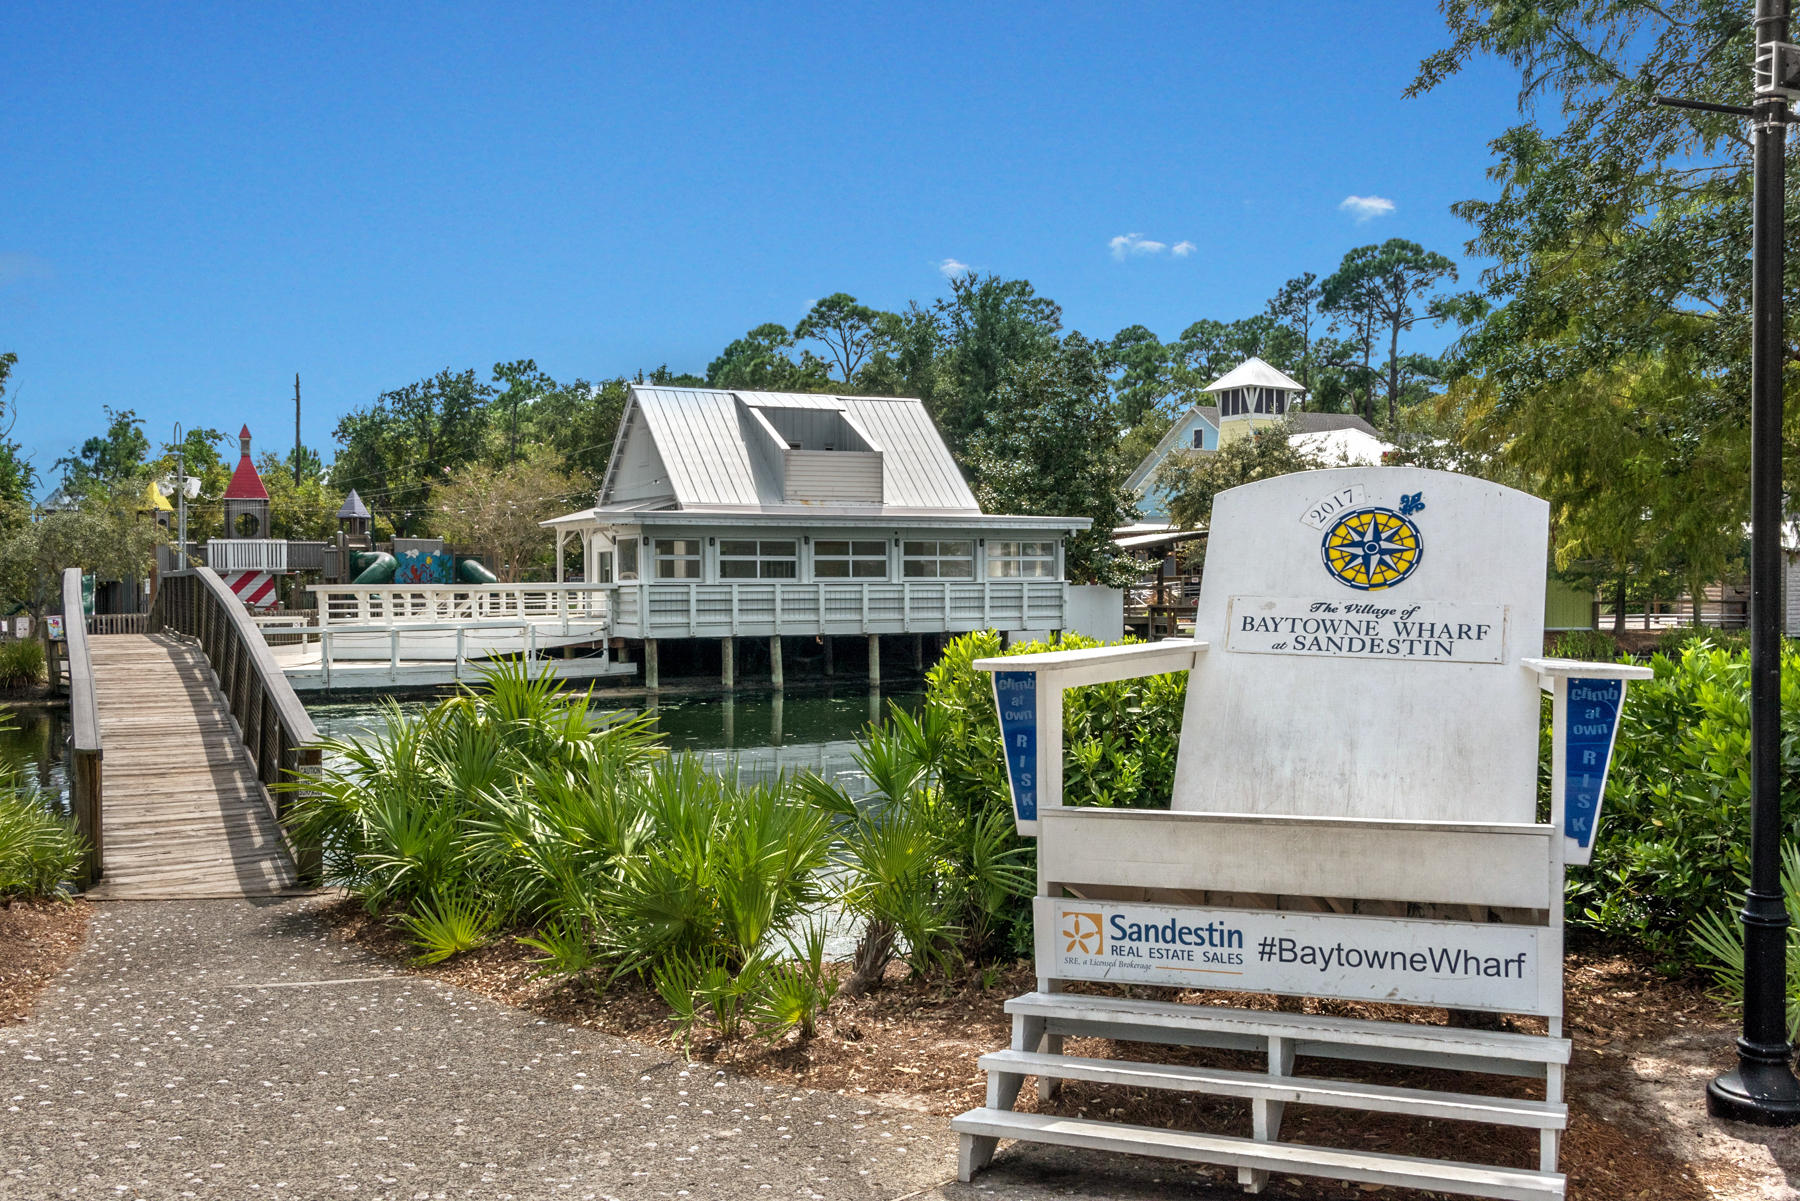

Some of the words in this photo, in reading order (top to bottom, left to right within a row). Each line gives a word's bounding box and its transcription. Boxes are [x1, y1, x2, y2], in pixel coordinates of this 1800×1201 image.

[1310, 487, 1356, 524] 2017
[1309, 602, 1339, 614] The
[1344, 603, 1397, 619] Village
[1400, 605, 1421, 620] of
[1241, 615, 1380, 637] BAYTOWNE
[1393, 621, 1491, 641] WHARF
[1271, 641, 1288, 650] at
[1293, 635, 1455, 657] SANDESTIN
[1005, 710, 1032, 721] own
[1585, 706, 1602, 720] at
[1573, 724, 1608, 735] own
[1110, 914, 1243, 949] Sandestin
[1111, 944, 1143, 958] REAL
[1149, 948, 1194, 962] ESTATE
[1203, 952, 1243, 965] SALES
[1258, 936, 1527, 979] #BaytowneWharf
[1090, 958, 1117, 967] Licensed
[1118, 960, 1152, 973] Brokerage
